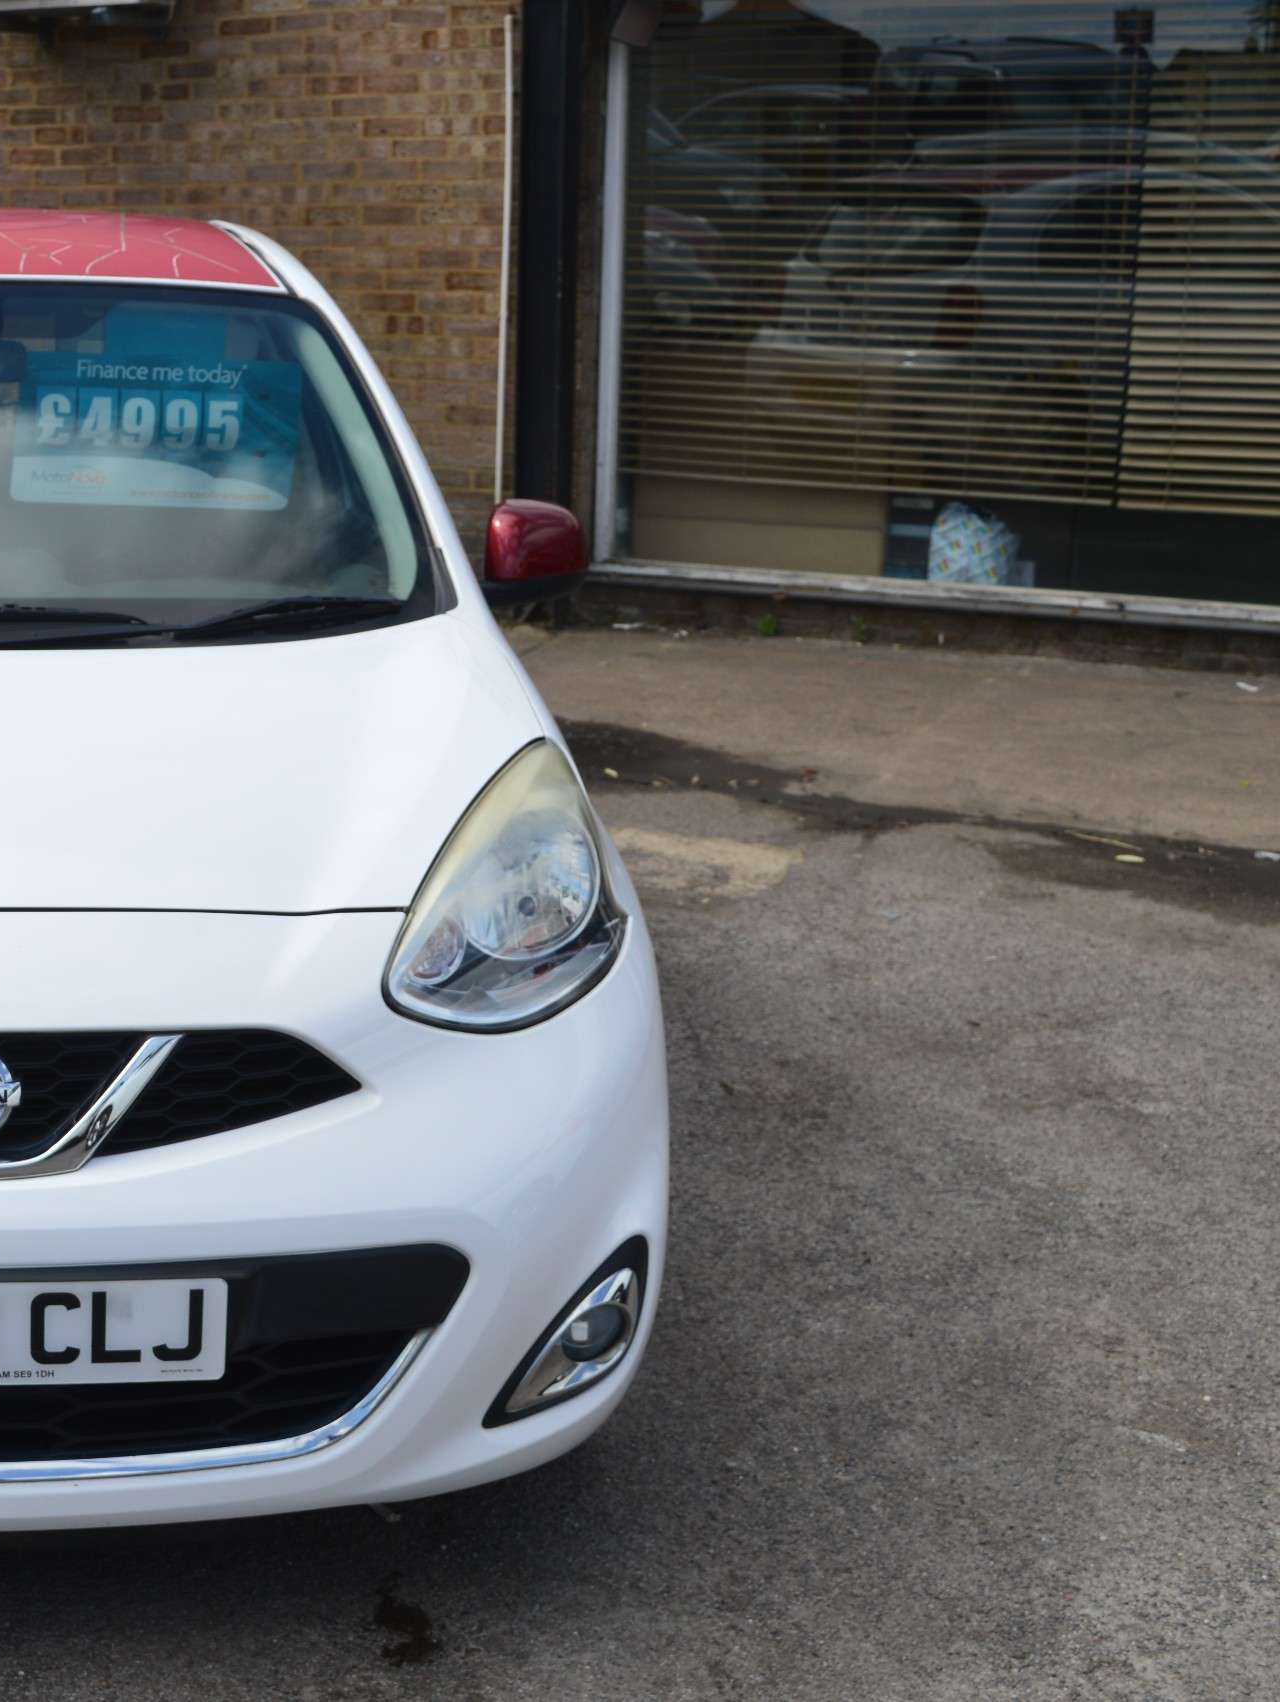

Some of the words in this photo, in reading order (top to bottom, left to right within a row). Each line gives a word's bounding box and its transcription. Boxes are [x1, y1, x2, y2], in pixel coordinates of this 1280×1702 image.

[76, 359, 149, 380] Finance
[152, 365, 185, 382] me
[36, 393, 240, 451] £4995
[30, 1288, 205, 1364] CLJ
[13, 1370, 32, 1378] SE9
[35, 1369, 55, 1378] 1DH
